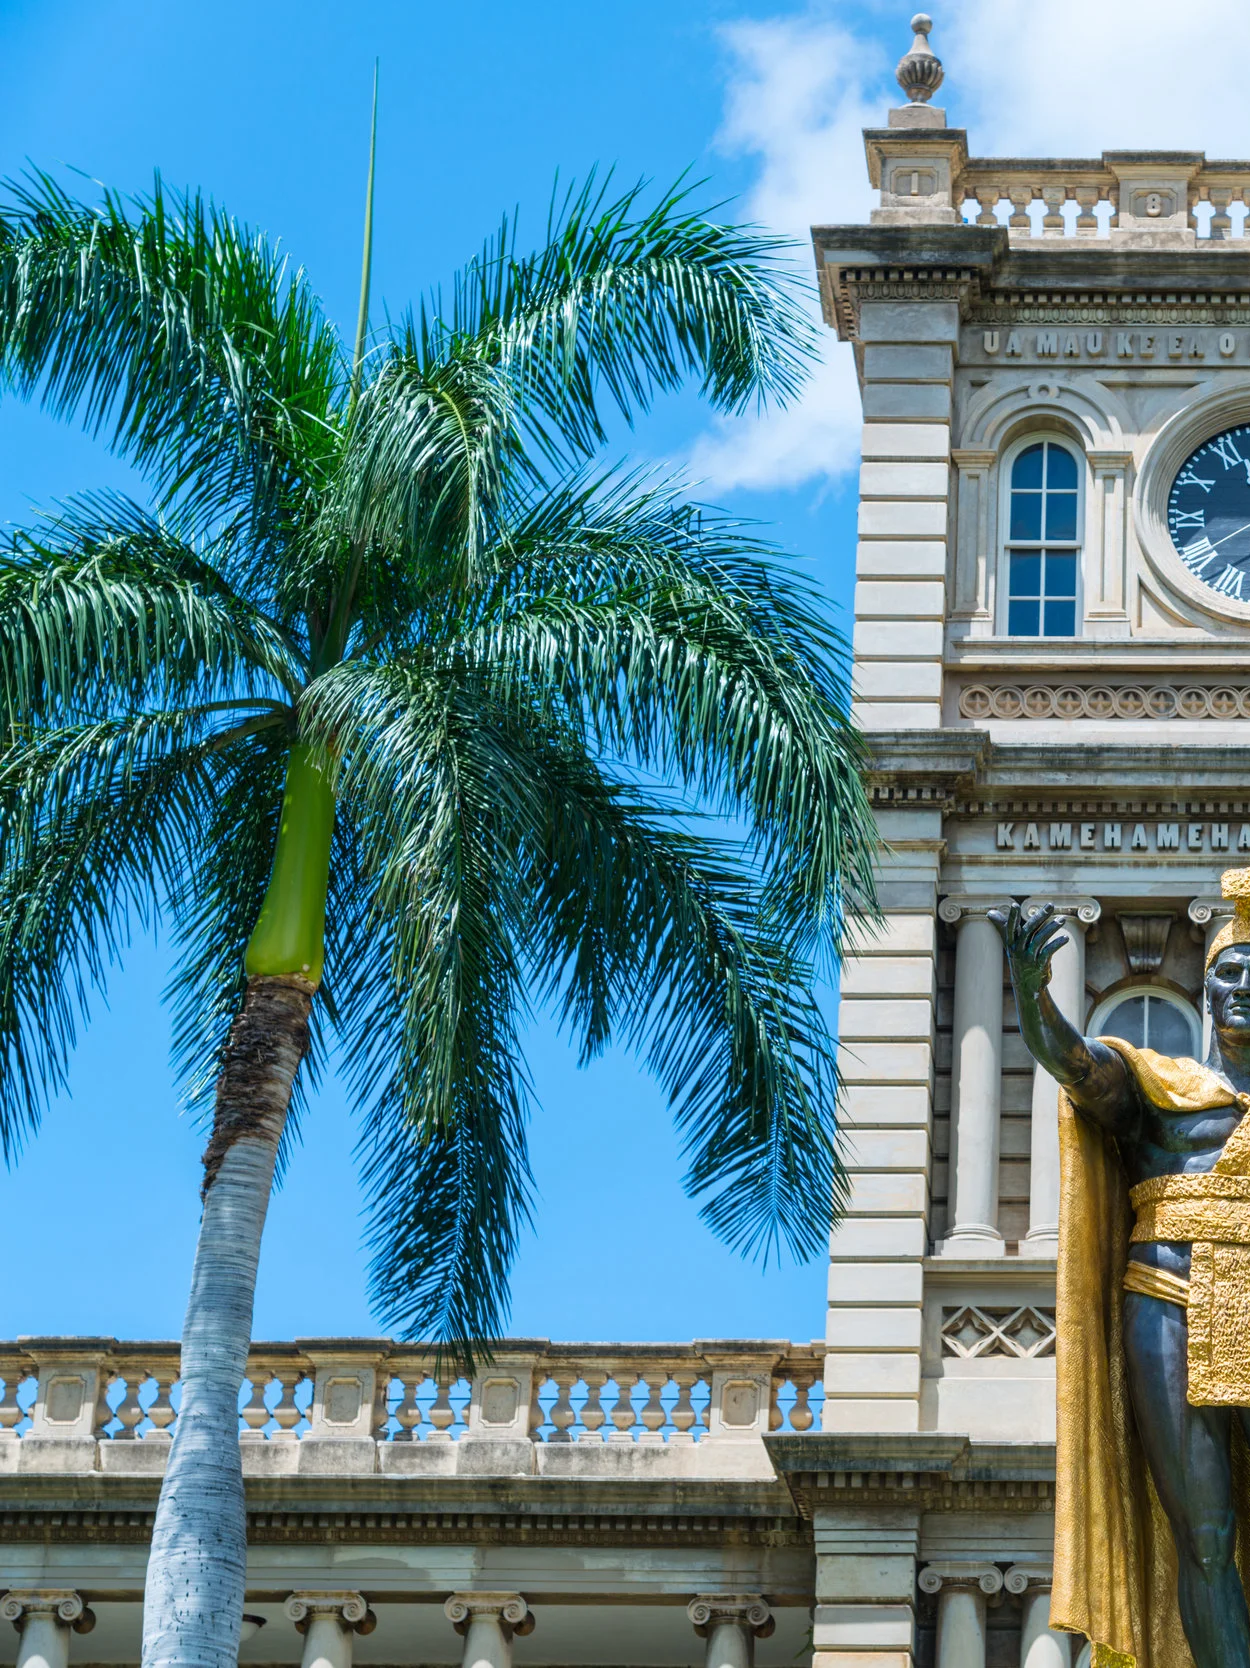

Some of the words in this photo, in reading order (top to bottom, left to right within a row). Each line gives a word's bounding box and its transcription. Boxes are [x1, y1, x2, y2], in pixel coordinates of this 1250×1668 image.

[1146, 193, 1162, 218] 8
[983, 331, 1022, 357] UA
[1036, 331, 1103, 358] MAU
[1116, 332, 1155, 358] KE
[1168, 332, 1205, 358] EA
[1219, 332, 1236, 357] O
[1212, 438, 1243, 470] XI
[1183, 471, 1216, 493] X
